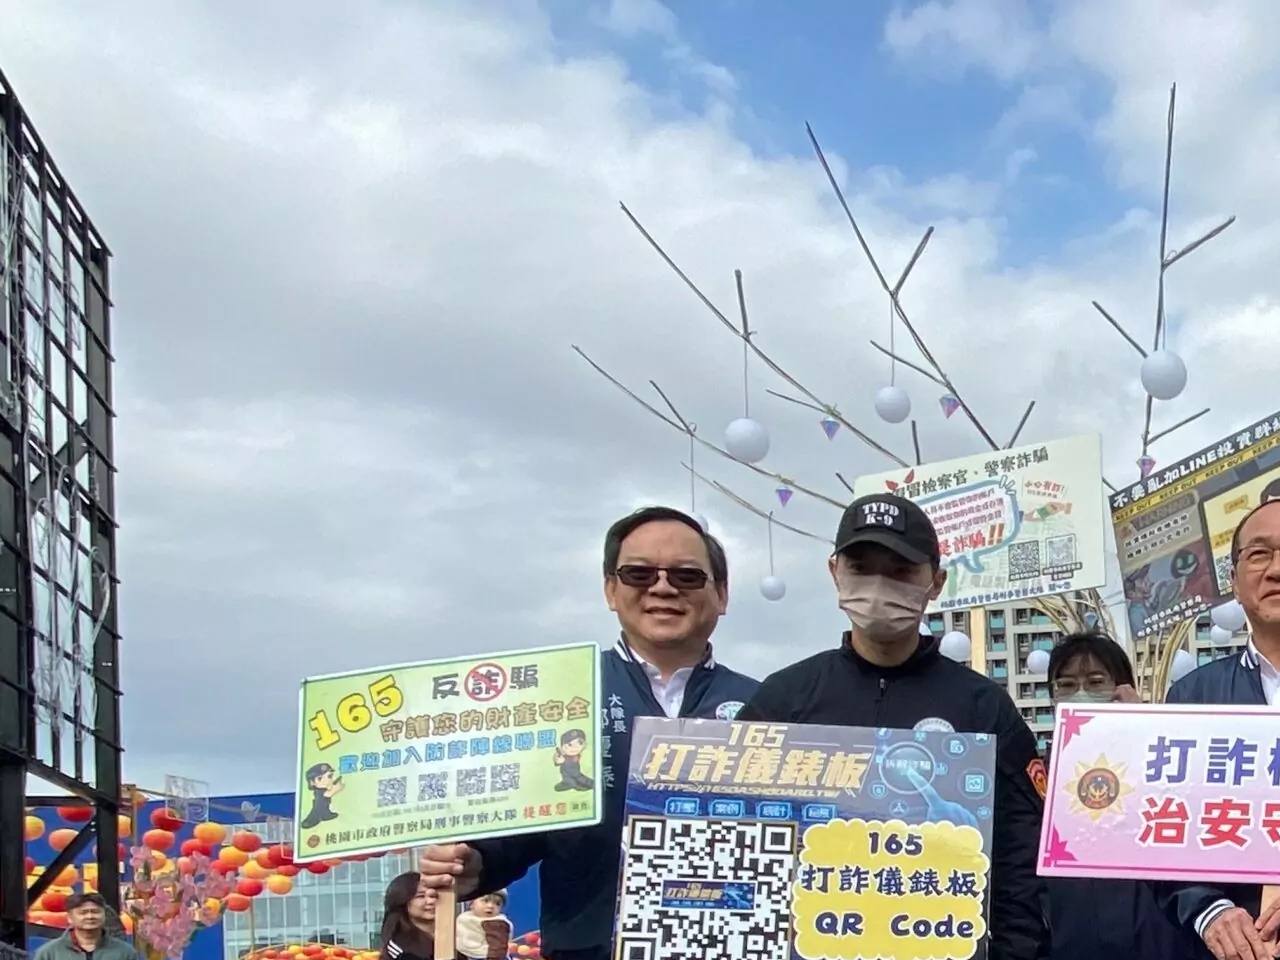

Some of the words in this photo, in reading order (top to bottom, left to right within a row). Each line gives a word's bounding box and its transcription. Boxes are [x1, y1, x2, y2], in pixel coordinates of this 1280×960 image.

[862, 502, 899, 517] TYPD
[865, 513, 894, 526] K-9
[432, 664, 539, 700] 反詐騙
[309, 675, 404, 750] 165
[380, 696, 591, 742] 守護您的財產安全
[728, 724, 788, 747] 165
[643, 743, 871, 789] 打詐儀錶板
[325, 808, 518, 845] 桃園市政府警察局刑事警察大隊
[869, 832, 923, 856] 165
[801, 865, 983, 898] 打詐儀錶板
[815, 913, 864, 937] QR
[891, 914, 974, 940] Code
